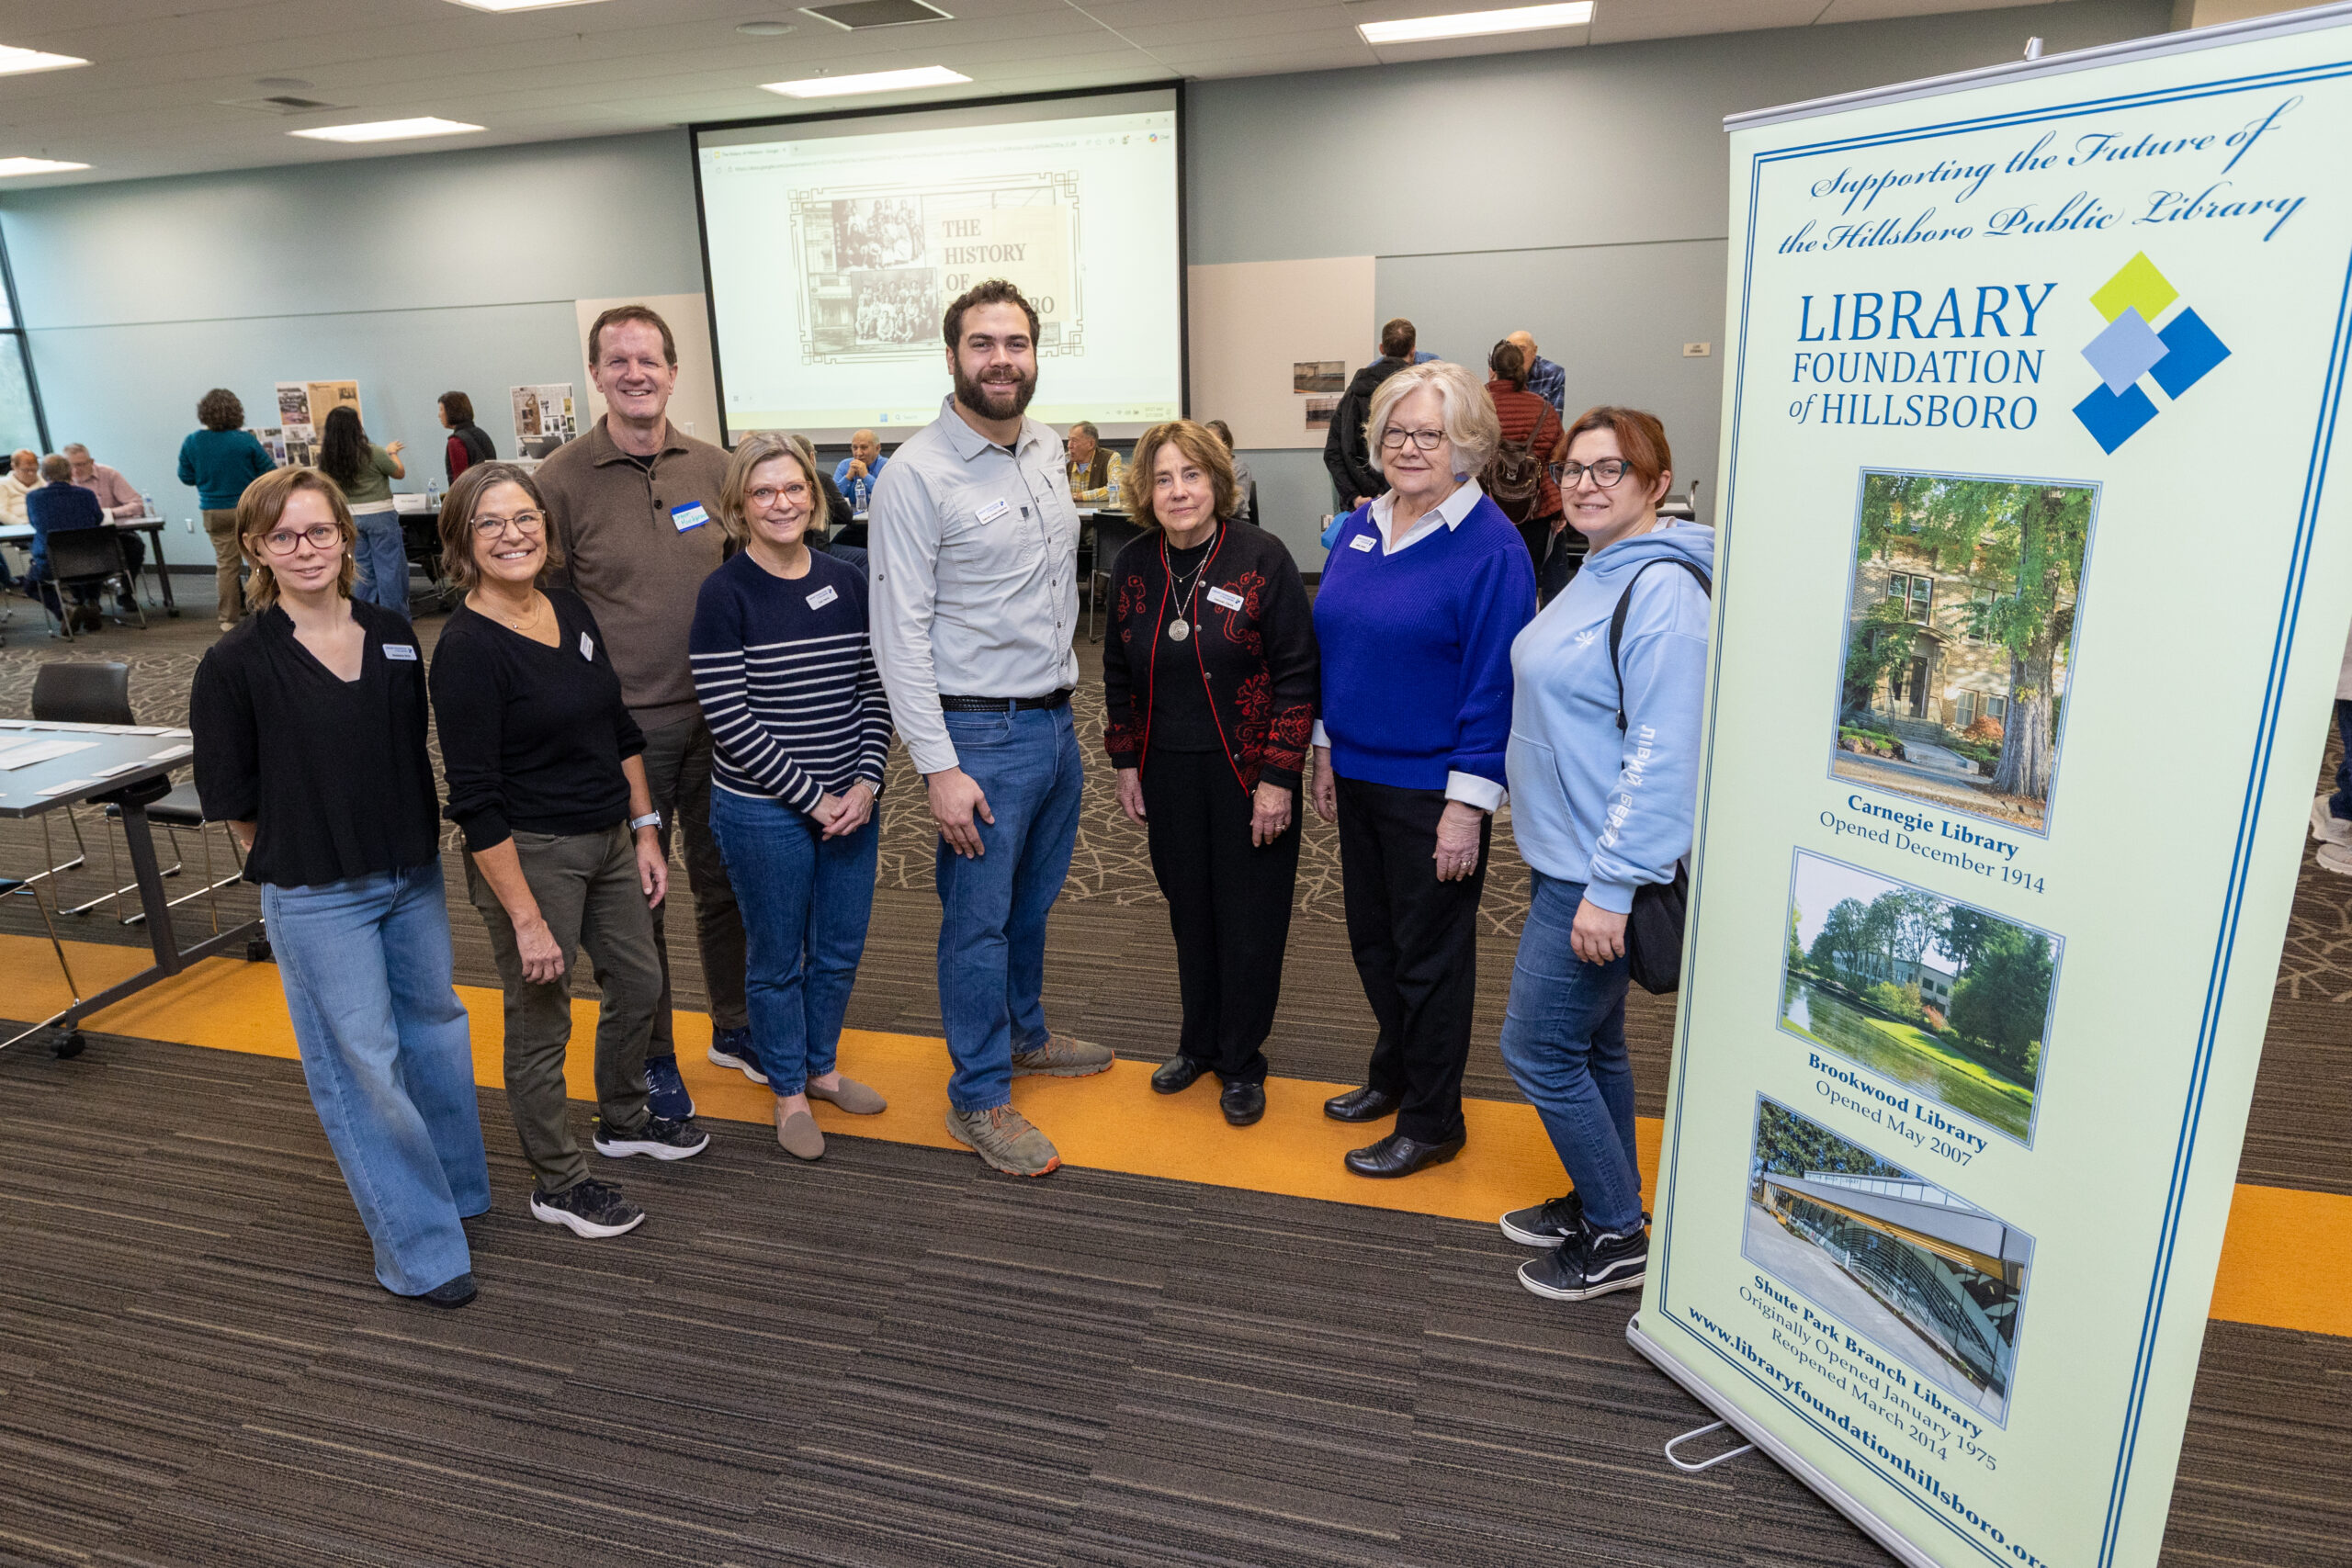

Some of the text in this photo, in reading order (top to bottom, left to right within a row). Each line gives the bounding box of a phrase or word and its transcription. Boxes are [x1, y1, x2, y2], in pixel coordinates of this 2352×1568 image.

[1810, 95, 2304, 216] Supporting the Future of
[942, 219, 981, 238] THE
[944, 243, 1026, 265] HISTORY
[1778, 180, 2307, 254] the Hillsboro Public Library
[945, 273, 970, 291] OF
[1797, 283, 2058, 342] LIBRARY
[1792, 349, 2045, 383] FOUNDATION
[1789, 393, 2038, 429] of HILLSBORO
[1626, 725, 1656, 787] ЛІВИЙ
[1820, 810, 2045, 894] Opened December 1914
[1848, 795, 2019, 861] Carnegie Library
[1808, 1053, 1988, 1154] Brookwood Library
[1816, 1080, 1973, 1167] Opened May 2007
[1739, 1286, 1996, 1471] Originally Opened January 1975
[1754, 1275, 1983, 1438] Shute Park Branch Library
[1771, 1327, 1948, 1461] Reopened March 2014
[1689, 1306, 2048, 1568] www.libraryfoundationhillsboro.or
